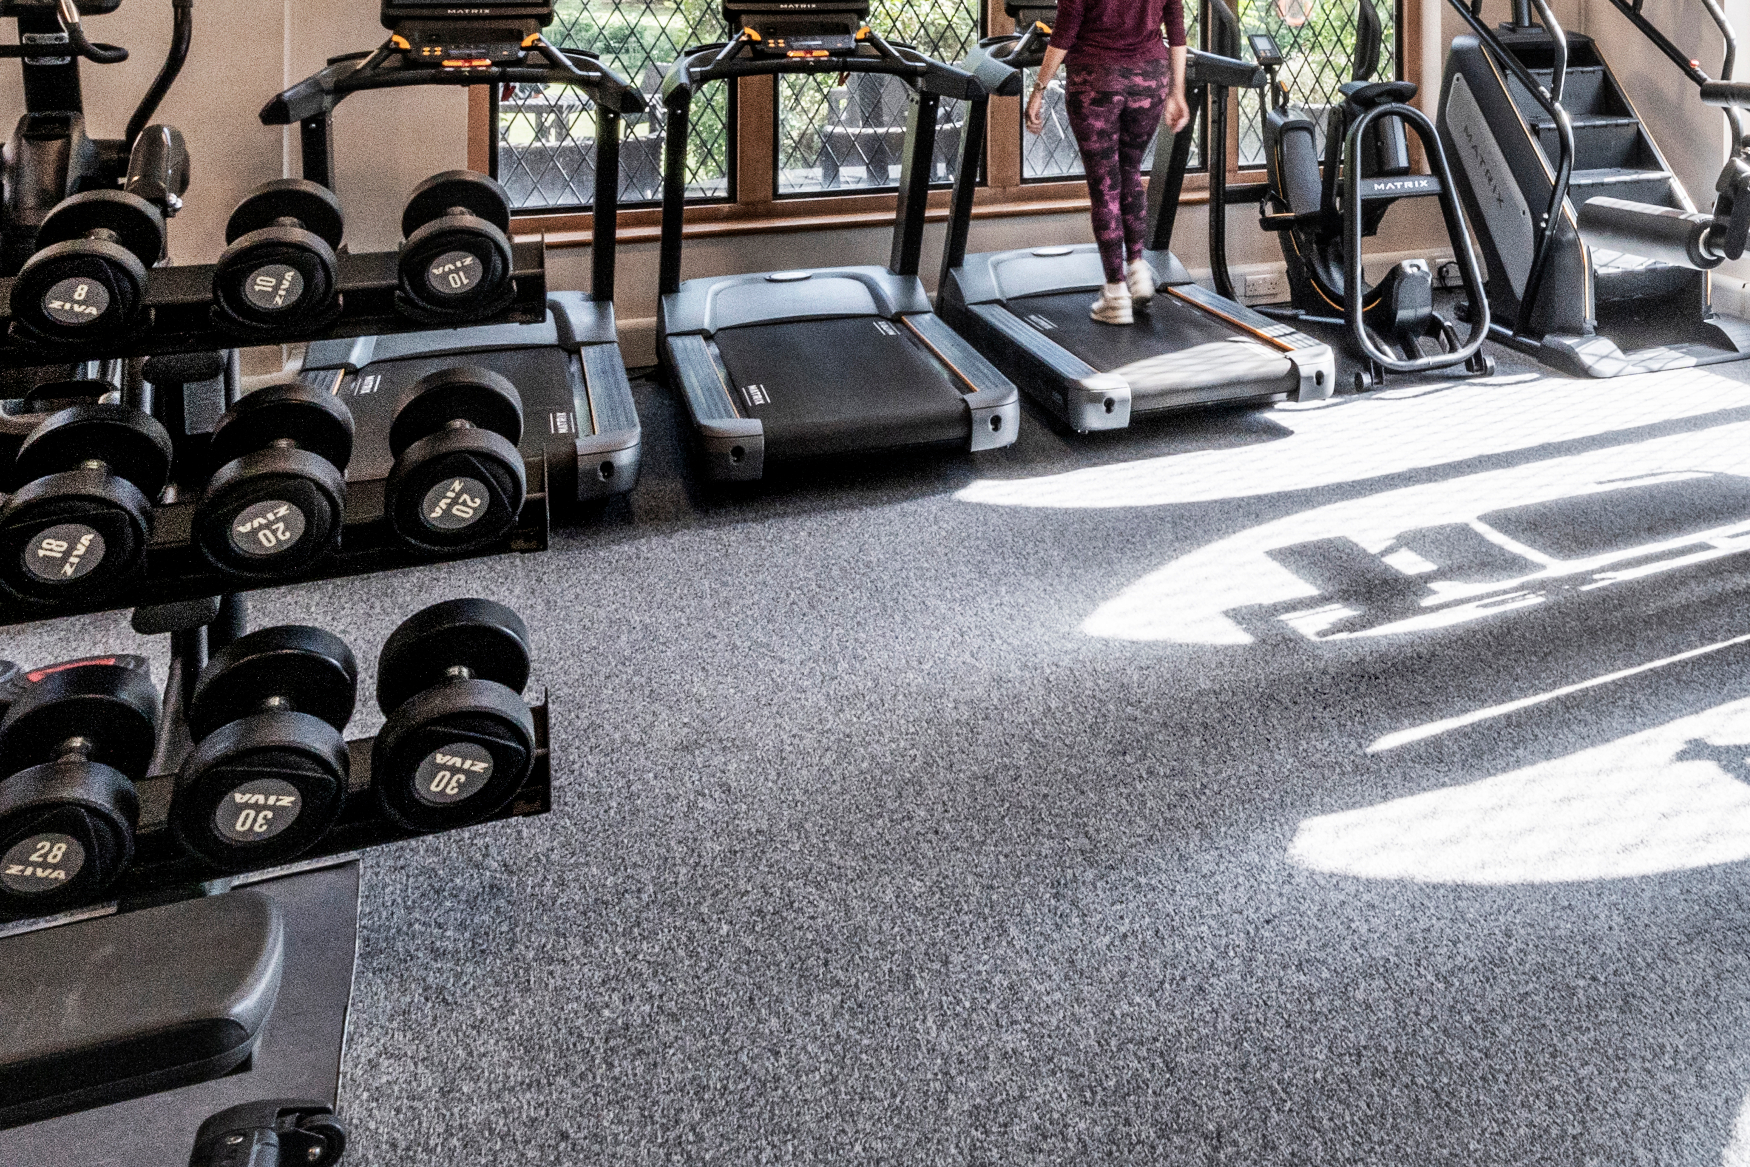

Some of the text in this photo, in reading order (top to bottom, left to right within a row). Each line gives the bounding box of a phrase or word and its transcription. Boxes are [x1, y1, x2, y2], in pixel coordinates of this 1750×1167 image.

[1463, 124, 1504, 209] MATRIX
[1374, 179, 1430, 190] MATRIX
[431, 256, 474, 275] ZIVA
[254, 276, 276, 292] 10
[273, 271, 295, 306] ZIVA
[448, 271, 470, 288] 10
[73, 284, 88, 301] 8
[49, 300, 99, 316] ZIVA
[430, 480, 464, 519] ZIVA
[451, 493, 481, 519] 20
[236, 504, 290, 533] ZIVA
[258, 522, 291, 548] 20
[37, 538, 68, 558] 18
[60, 533, 95, 576] ZIVA
[435, 752, 489, 773] ZIVA
[429, 770, 466, 795] 30
[234, 792, 296, 808] ZIVA
[234, 809, 274, 833] 30
[28, 841, 67, 864] 28
[5, 864, 66, 880] ZIVA
